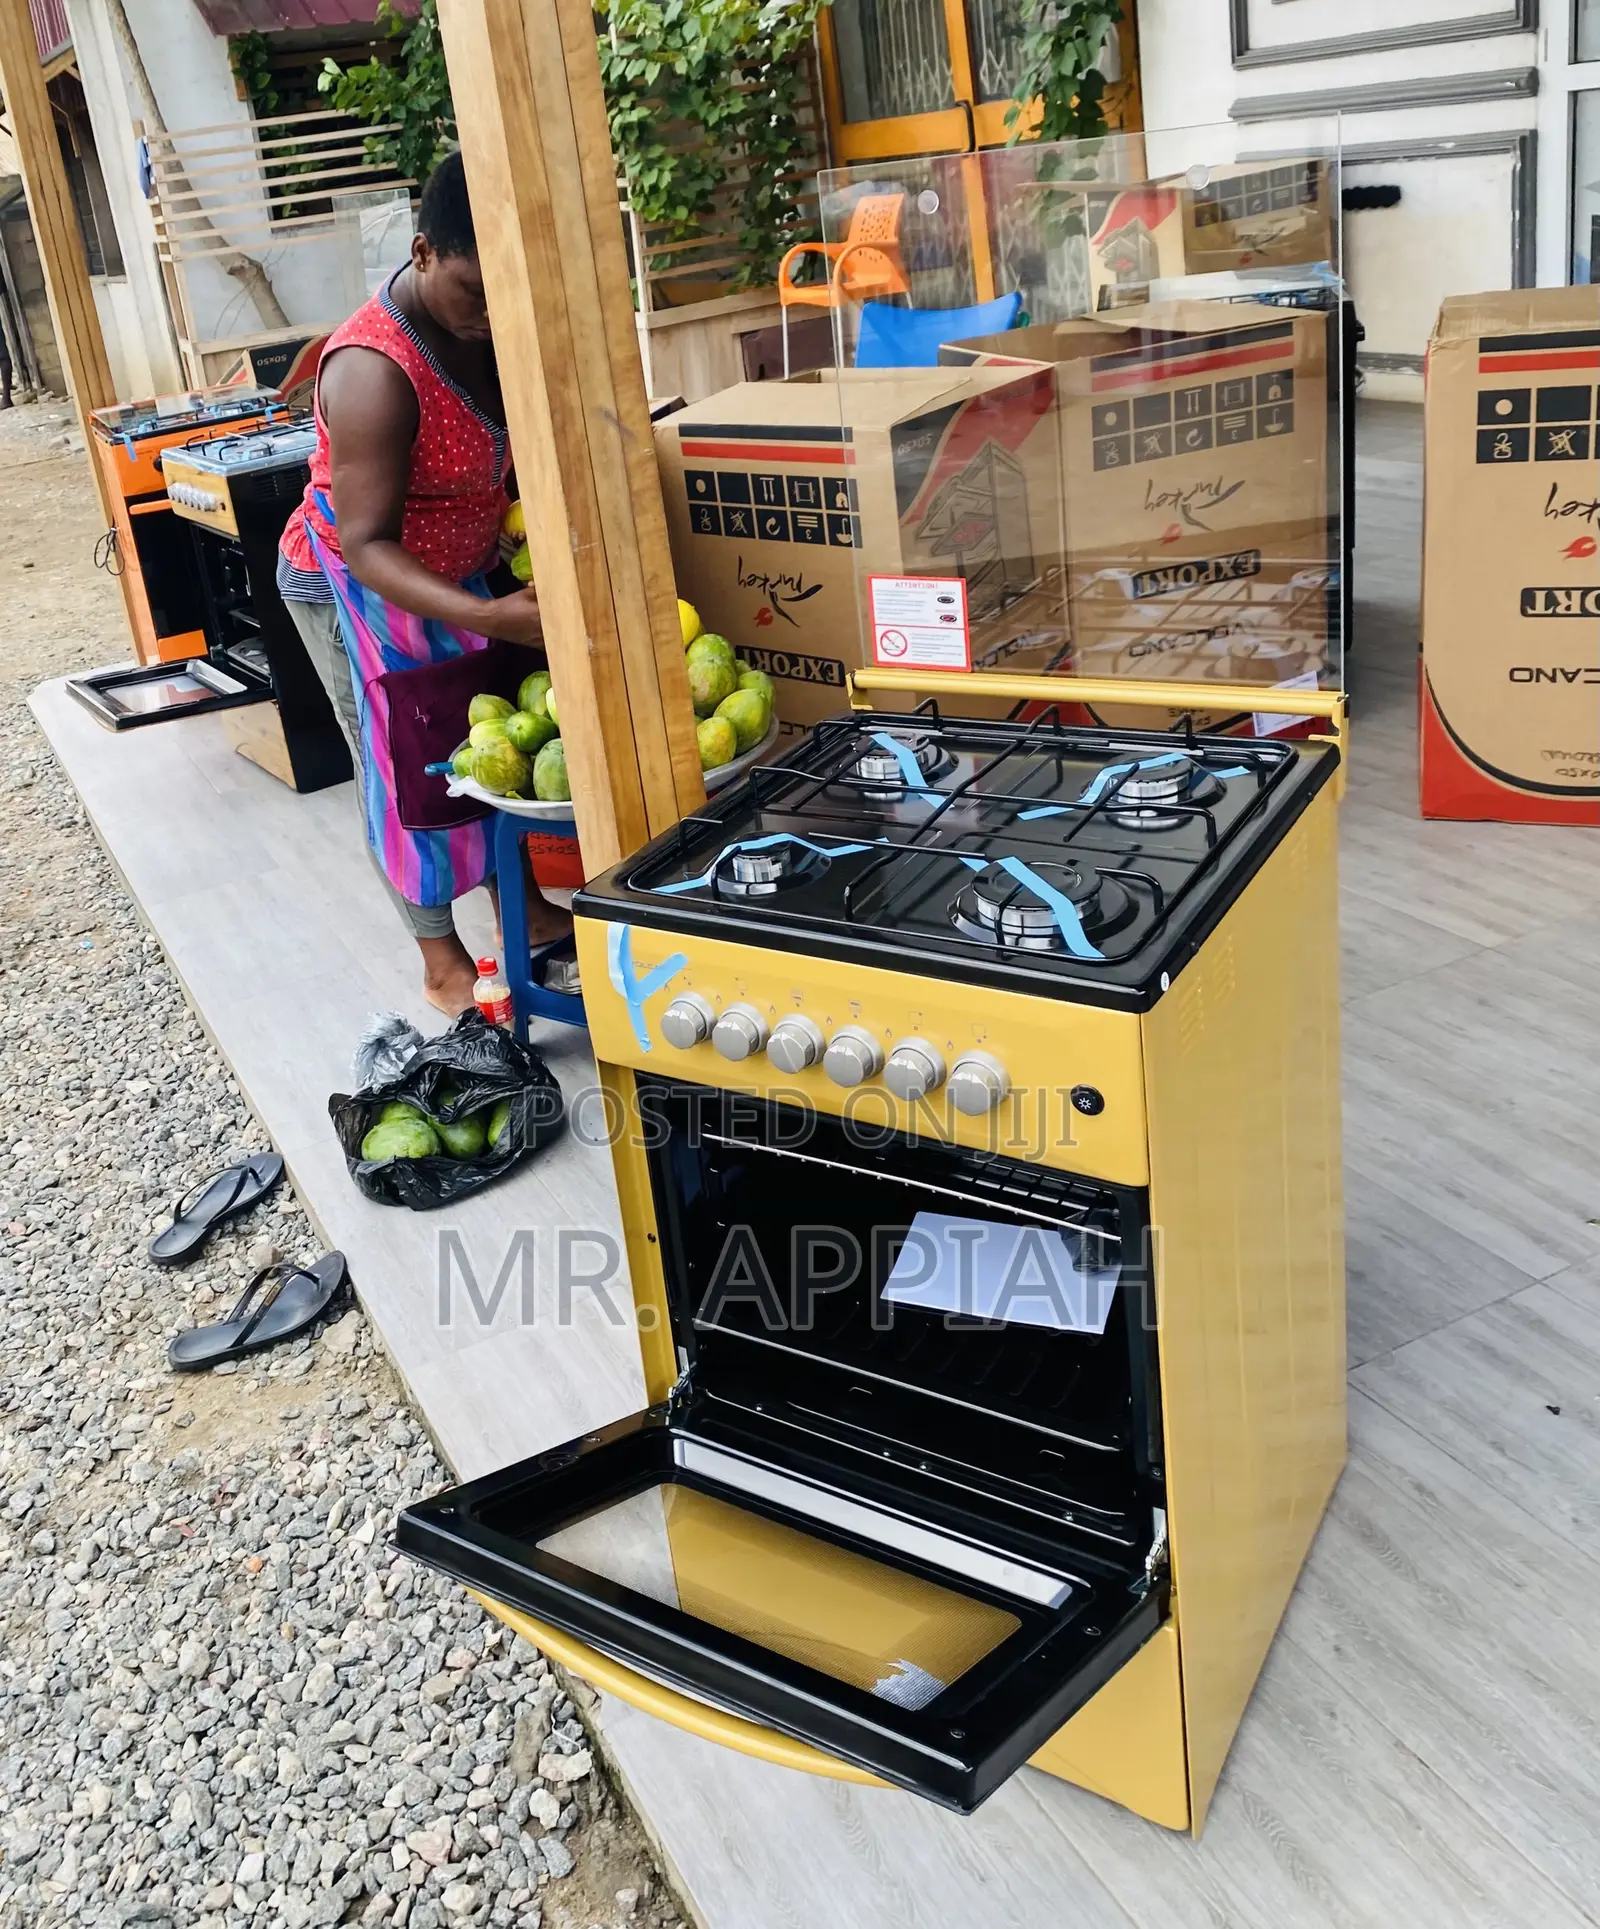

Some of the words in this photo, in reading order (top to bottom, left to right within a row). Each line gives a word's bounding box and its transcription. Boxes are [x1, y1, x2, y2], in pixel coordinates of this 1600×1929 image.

[257, 353, 287, 366] 50x50
[1144, 475, 1246, 516] Turkey
[737, 555, 823, 606] Turkey
[1137, 552, 1255, 596] EXPORT
[1129, 622, 1246, 658] VOLCANO
